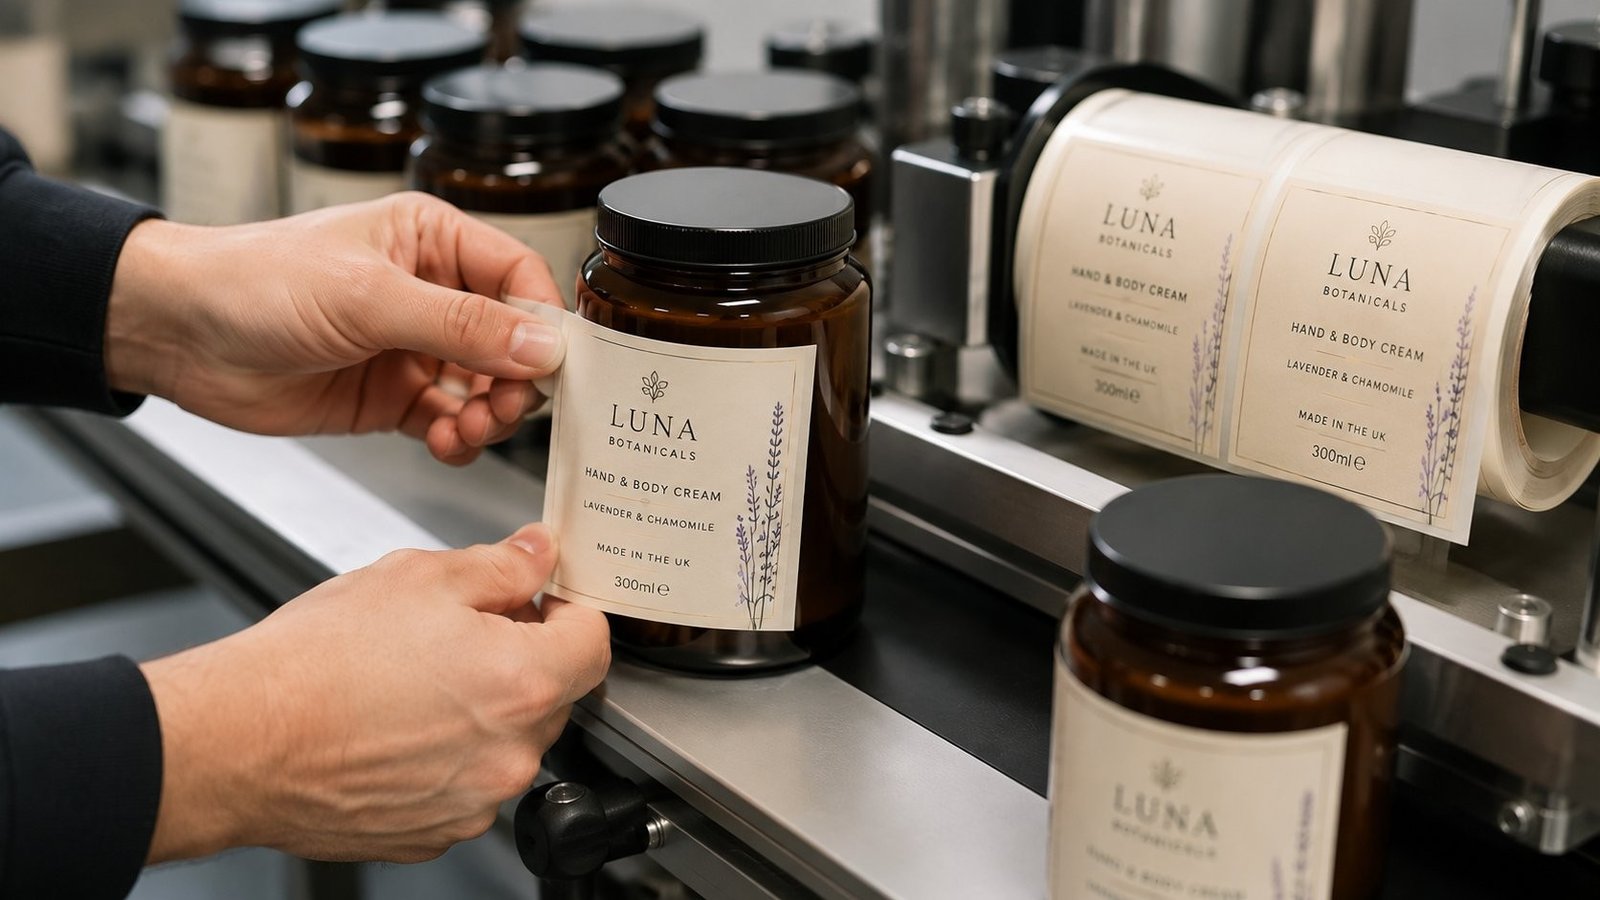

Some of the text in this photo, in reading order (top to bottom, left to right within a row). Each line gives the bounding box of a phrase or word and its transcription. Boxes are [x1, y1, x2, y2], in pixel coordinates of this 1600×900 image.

[1102, 204, 1176, 240] LUNA
[1098, 234, 1173, 258] BOTANICALS
[1071, 267, 1187, 304] HAND & BODY CREAM
[1327, 253, 1412, 292] LUNA
[1323, 286, 1407, 313] BOTANICALS
[1068, 300, 1178, 336] LAVENDER & CHAMOMILE
[1291, 322, 1424, 362] HAND & BODY CREAM
[1080, 346, 1157, 374] MADE IN THE UK
[1286, 360, 1414, 399] LAVENDER & CHAMOMILE
[610, 404, 697, 441] LUNA
[1298, 410, 1386, 441] MADE IN THE UK
[608, 437, 697, 461] BOTANICALS
[585, 467, 722, 502] HAND & BODY CREAM
[583, 500, 715, 532] LAVENDER & CHAMOMILE
[596, 542, 690, 567] MADE IN THE UK
[1113, 784, 1219, 840] LUNA
